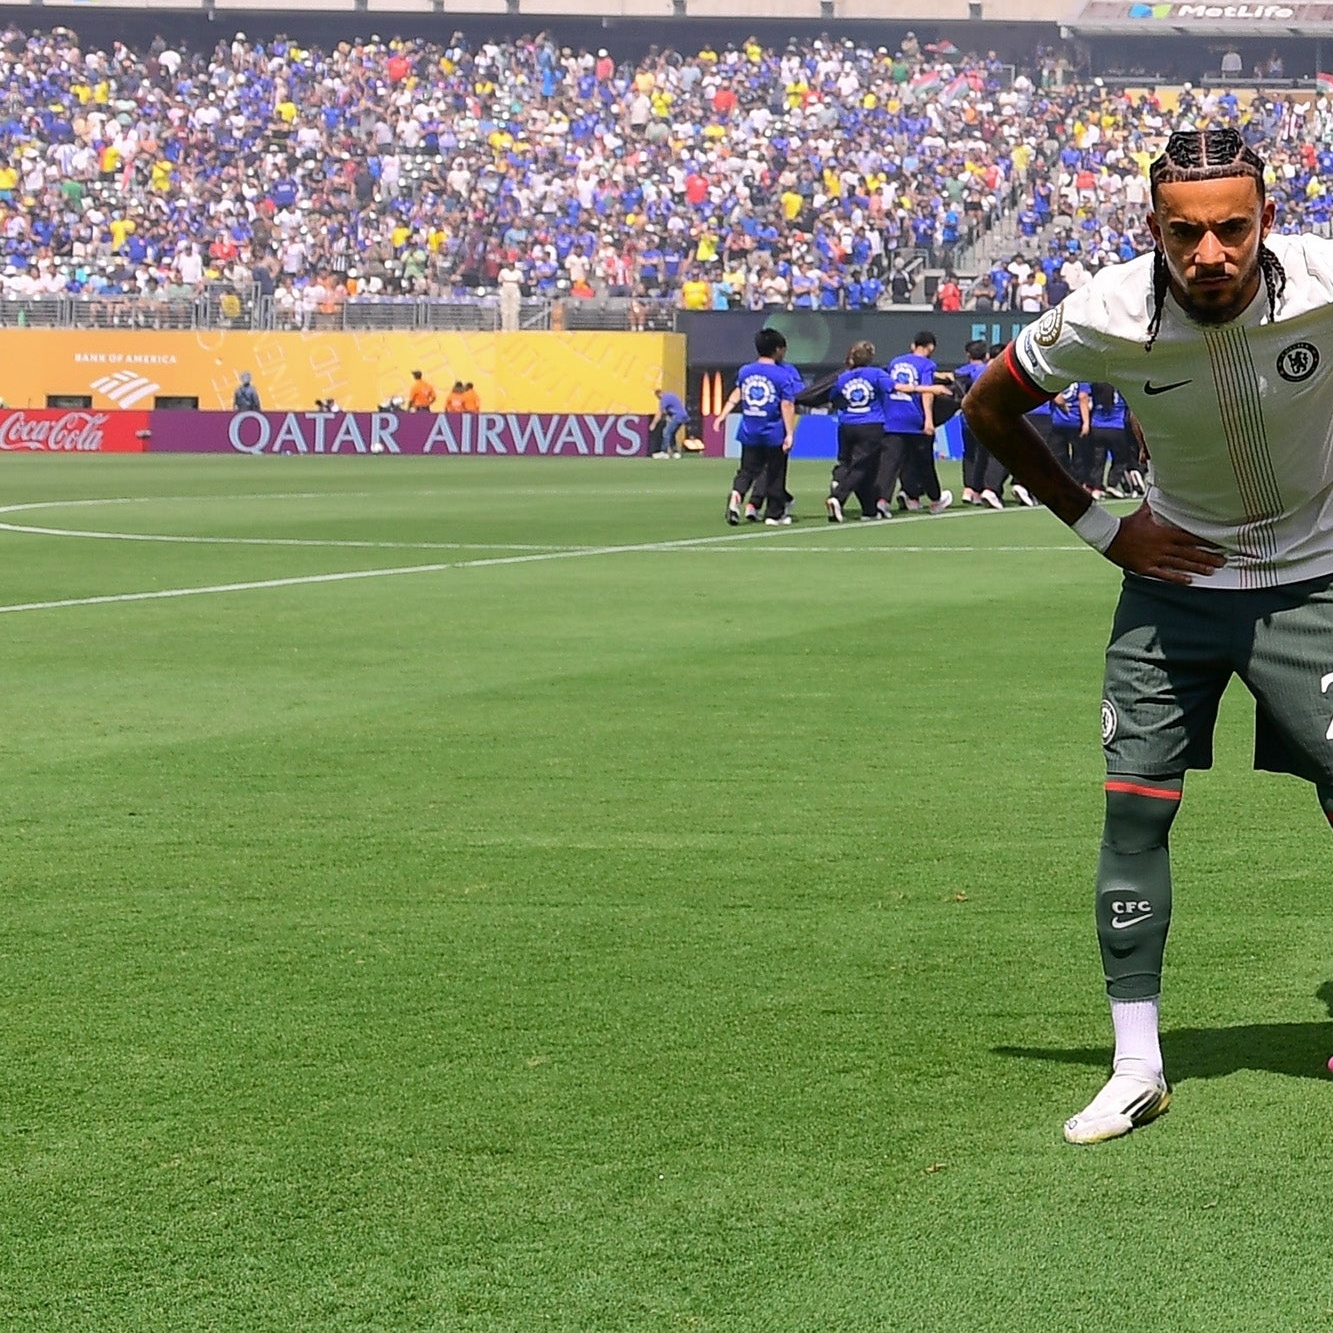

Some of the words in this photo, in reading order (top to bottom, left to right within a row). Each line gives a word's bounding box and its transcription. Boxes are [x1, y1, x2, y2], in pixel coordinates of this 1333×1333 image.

[1178, 4, 1294, 19] MetLife
[74, 353, 105, 363] BANK
[109, 353, 122, 363] OF
[125, 354, 177, 364] AMERICA
[0, 411, 108, 452] Coca-Cola
[228, 411, 400, 455] QATAR
[423, 413, 642, 456] AIRWAYS
[1112, 900, 1151, 914] CFC
